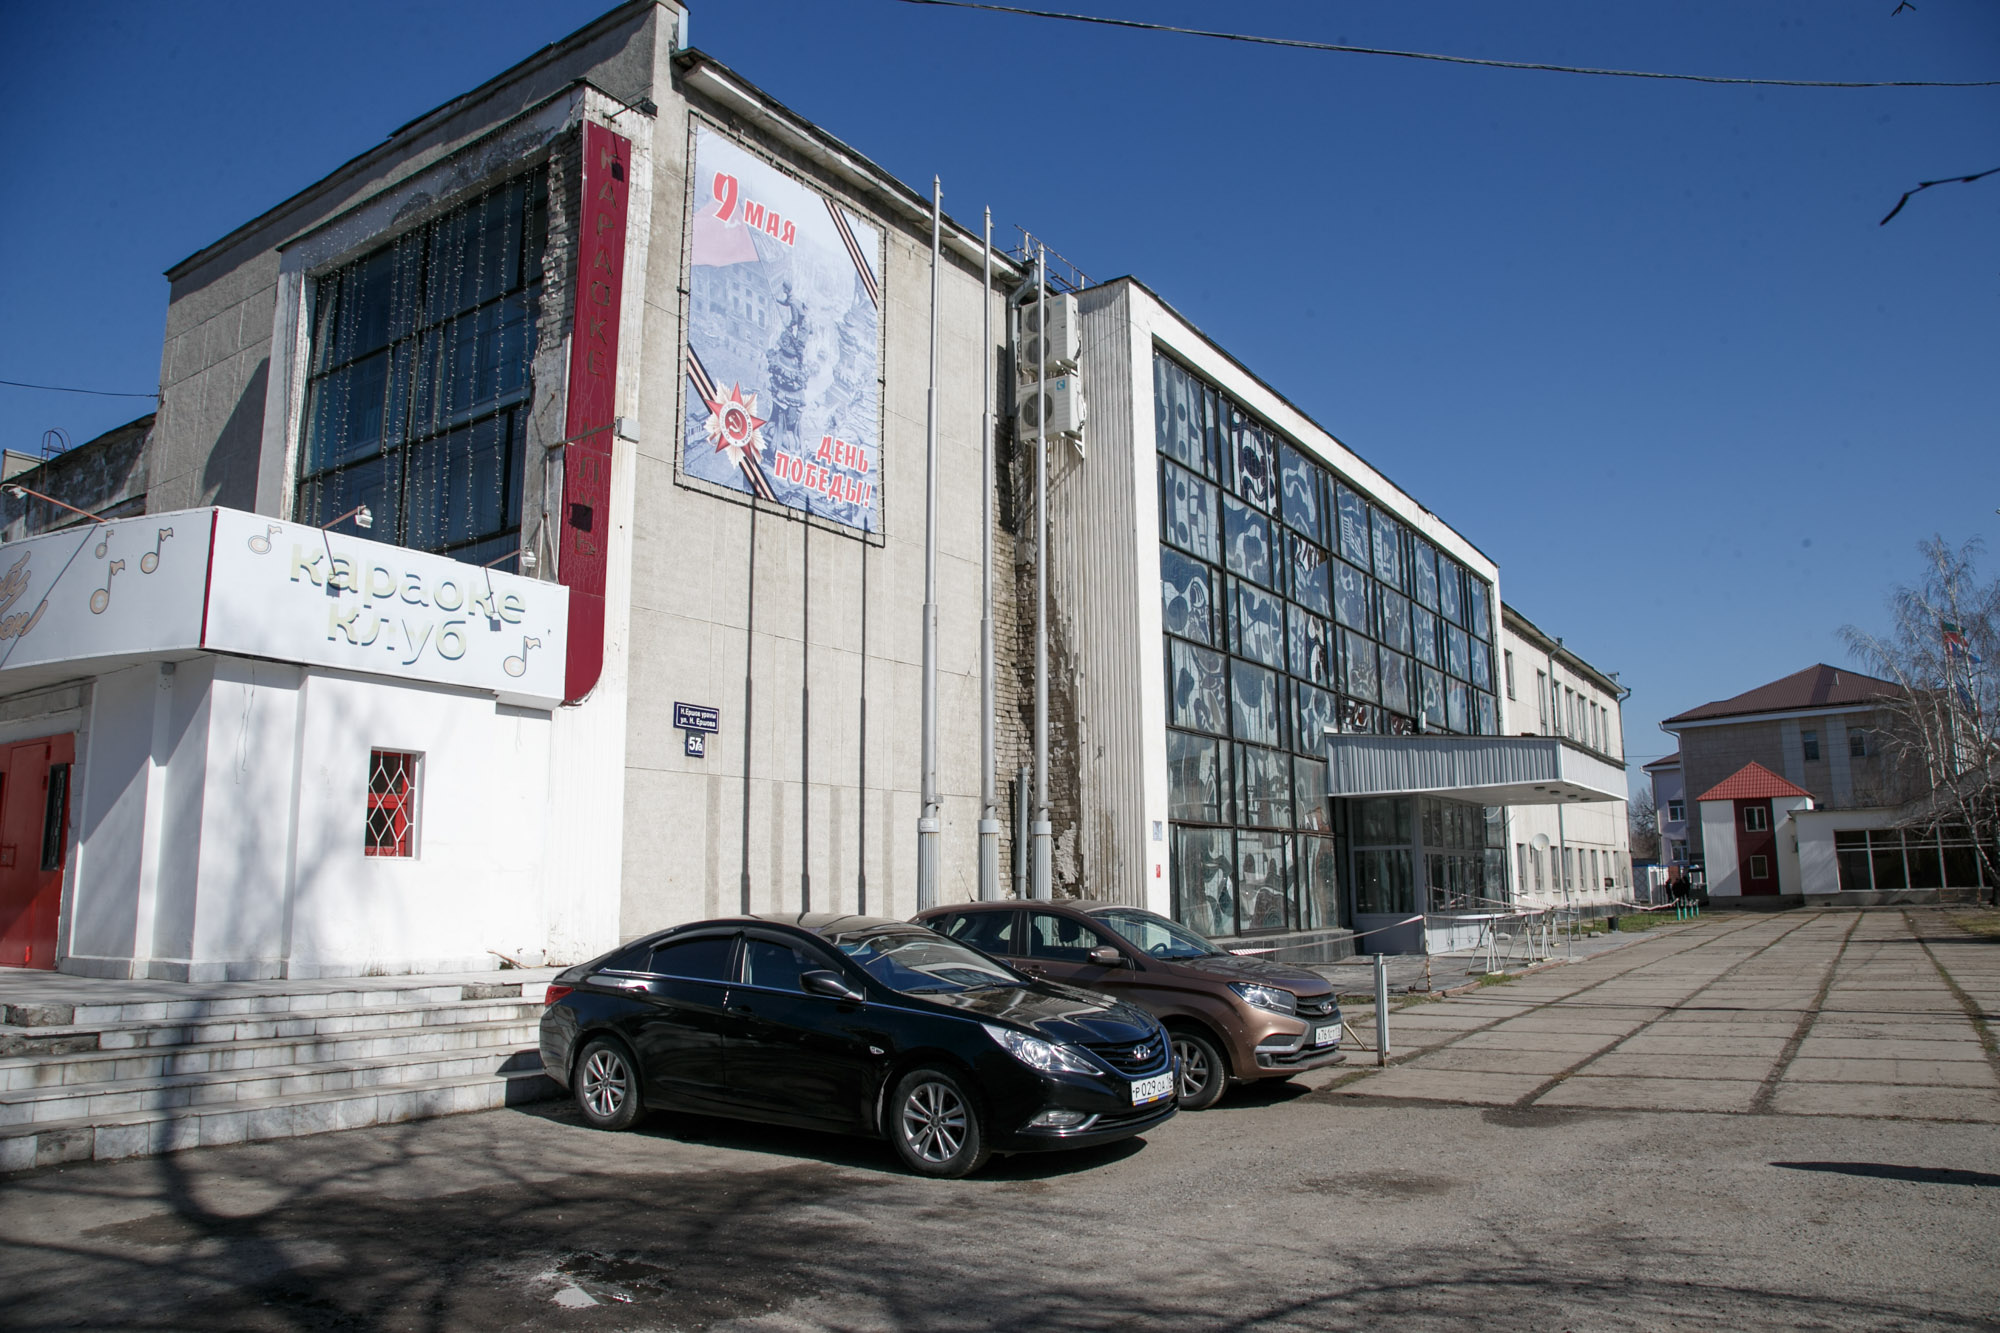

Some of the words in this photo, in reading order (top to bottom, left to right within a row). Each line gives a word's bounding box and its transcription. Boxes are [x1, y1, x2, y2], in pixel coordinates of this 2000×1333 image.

[713, 171, 738, 222] 9
[744, 199, 796, 247] МАЯ
[774, 451, 872, 507] ПОБЕДЫ!
[817, 435, 869, 474] ДЕНЬ
